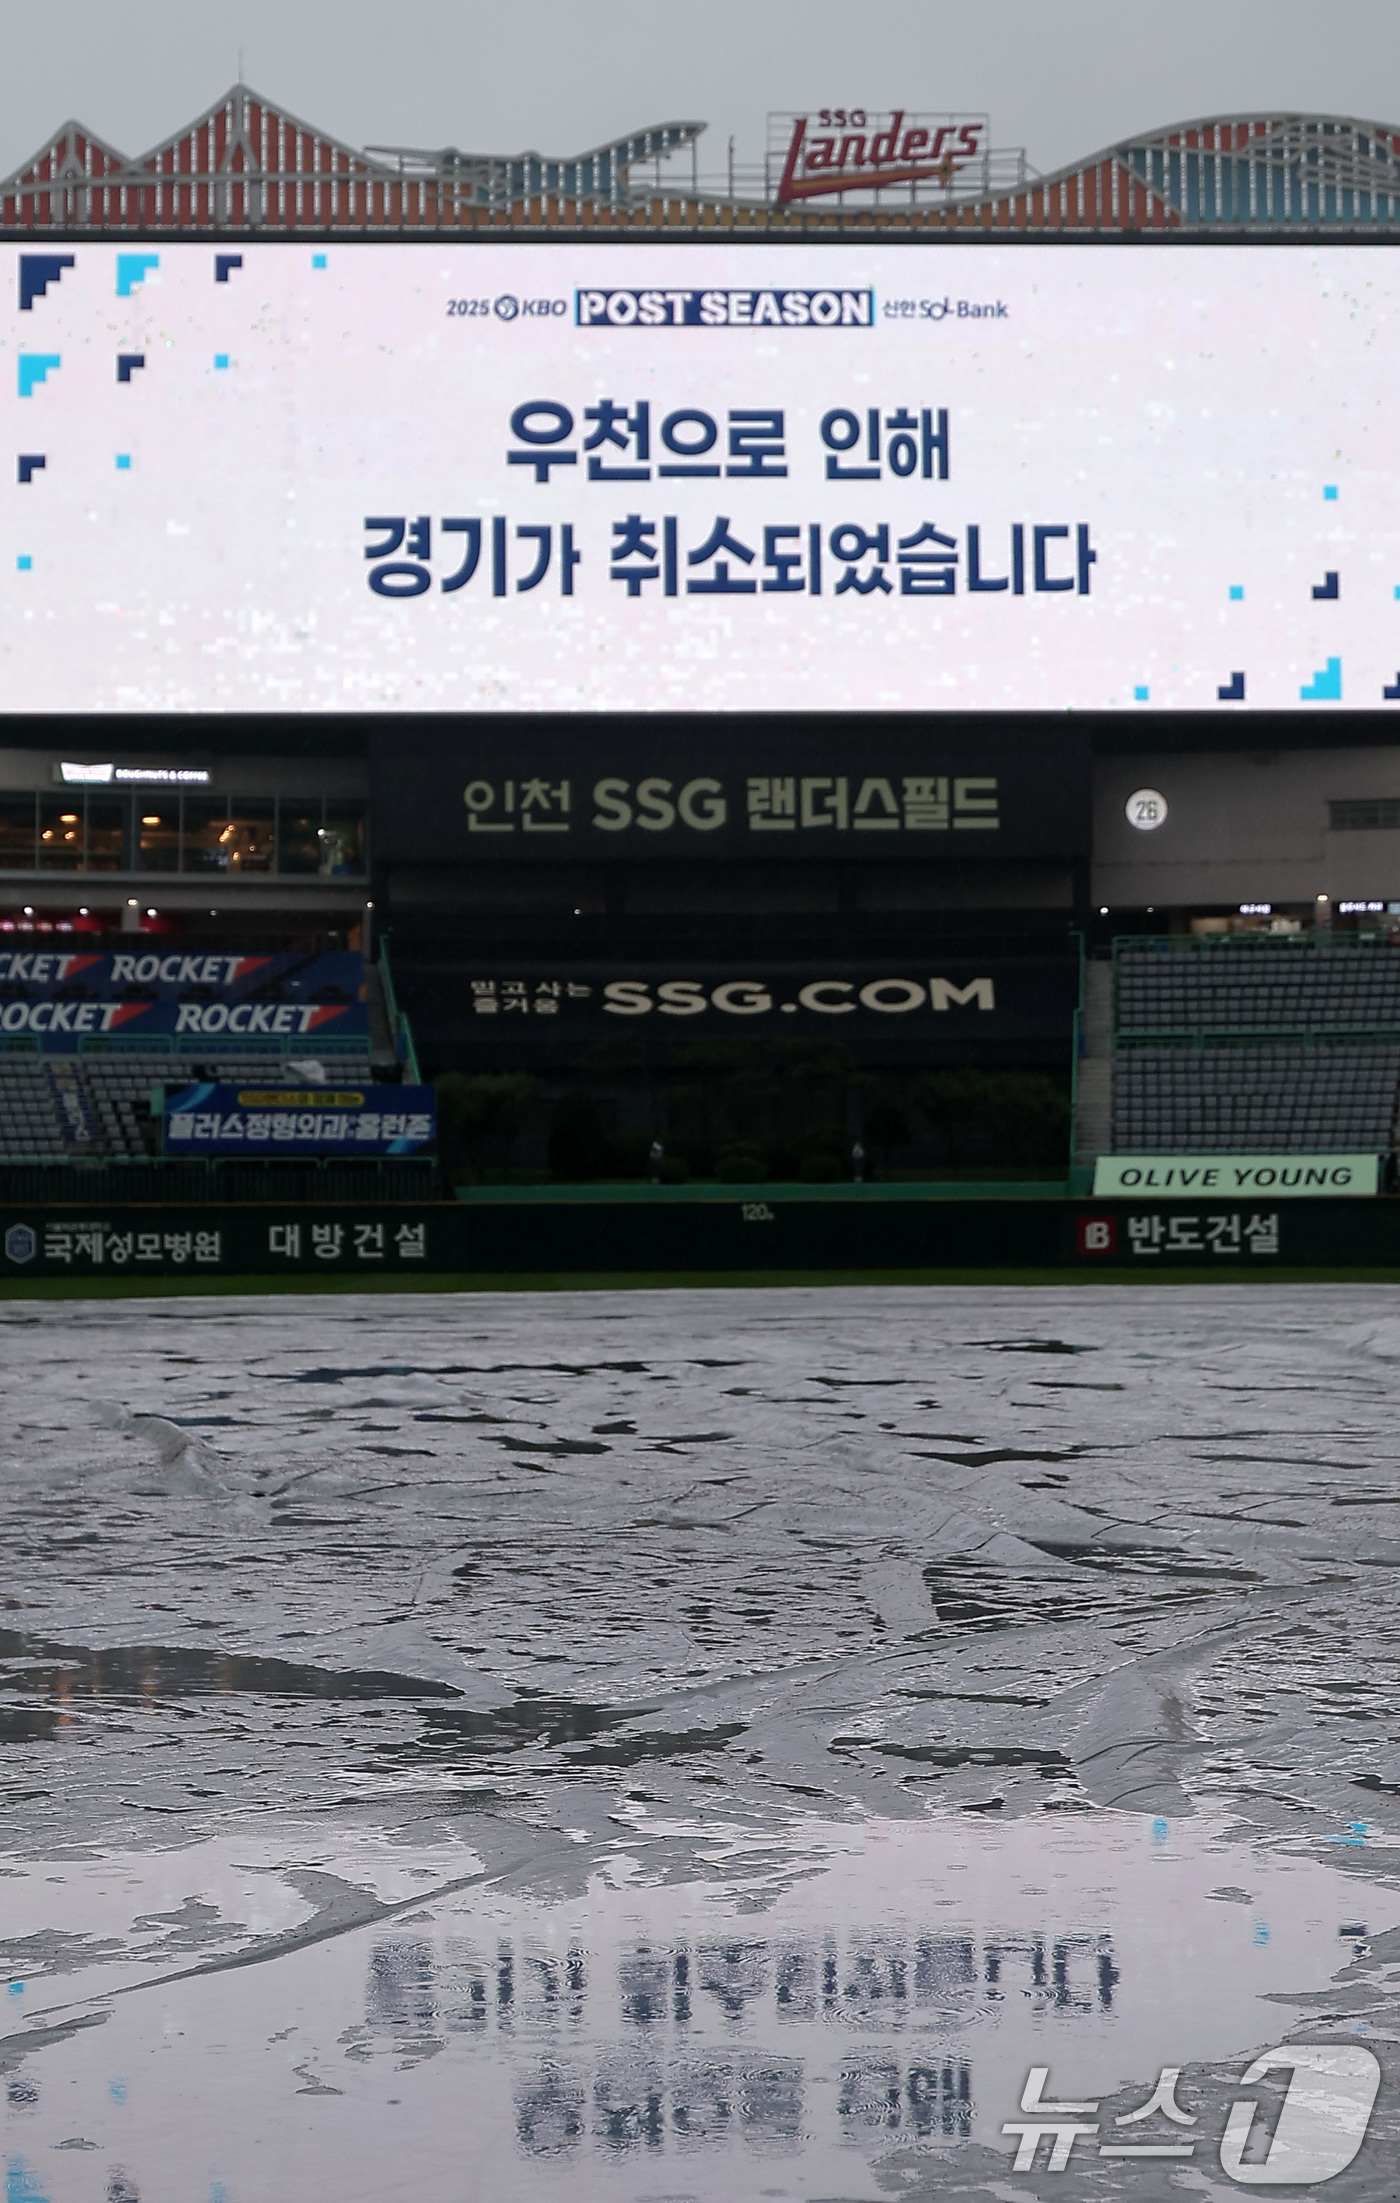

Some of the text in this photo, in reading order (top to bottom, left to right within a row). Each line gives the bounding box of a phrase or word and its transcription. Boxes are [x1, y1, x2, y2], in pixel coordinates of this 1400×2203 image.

[819, 110, 866, 127] SSG
[446, 299, 490, 317] 2025
[521, 299, 568, 317] KBO
[579, 291, 692, 326] POST
[699, 291, 870, 326] SEASON
[956, 300, 1009, 318] Bank
[507, 399, 951, 484] 우천으로 인해
[364, 514, 1098, 598] 경기가 취소되었습니다
[463, 776, 1000, 832] 인천 SSG 랜더스필드
[1135, 800, 1159, 821] 26
[111, 955, 246, 984] ROCKET
[602, 977, 995, 1016] SSG.COM
[0, 1004, 122, 1032] OCKET
[175, 1004, 321, 1033] ROCKET
[1119, 1167, 1352, 1187] OLIVE YOUNG
[44, 1230, 221, 1264] 국제성모병원
[268, 1222, 426, 1259] 대방건설
[1128, 1213, 1279, 1254] 반도건설
